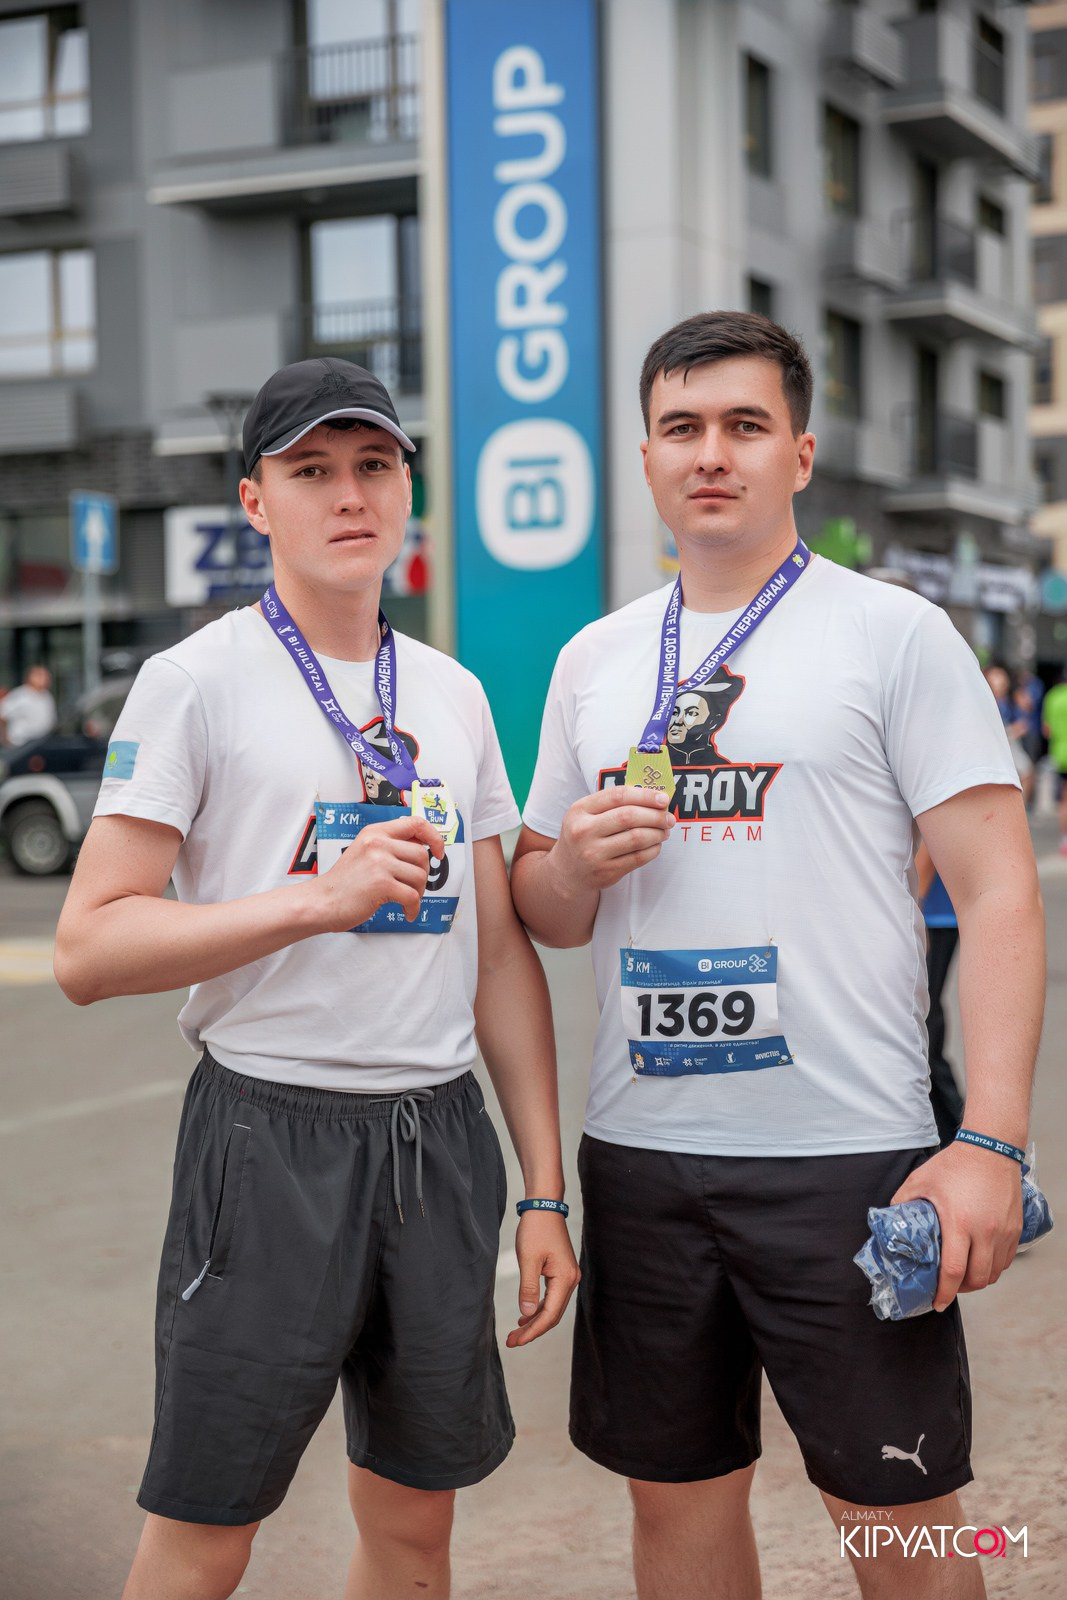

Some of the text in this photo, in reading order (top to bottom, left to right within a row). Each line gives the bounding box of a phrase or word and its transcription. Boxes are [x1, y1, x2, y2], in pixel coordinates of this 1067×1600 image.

[493, 45, 569, 532] BI GROUP
[266, 600, 280, 619] City
[666, 586, 680, 625] ВМЕСТЕ
[693, 636, 736, 682] ДОБРЫМ
[731, 573, 788, 639] ПЕРЕМЕНАМ
[287, 636, 325, 692] BI JULDYZAI
[662, 637, 677, 683] ДОБРЫМ
[361, 752, 386, 771] GROUP
[323, 809, 360, 825] 5 KM
[681, 825, 762, 842] TEAM
[626, 957, 650, 974] 5 KM
[700, 959, 748, 970] BI GROUP
[637, 990, 755, 1037] 1369
[755, 1050, 780, 1060] INVICTUS
[965, 1134, 993, 1147] JULDYZAI
[540, 1200, 557, 1209] 2025
